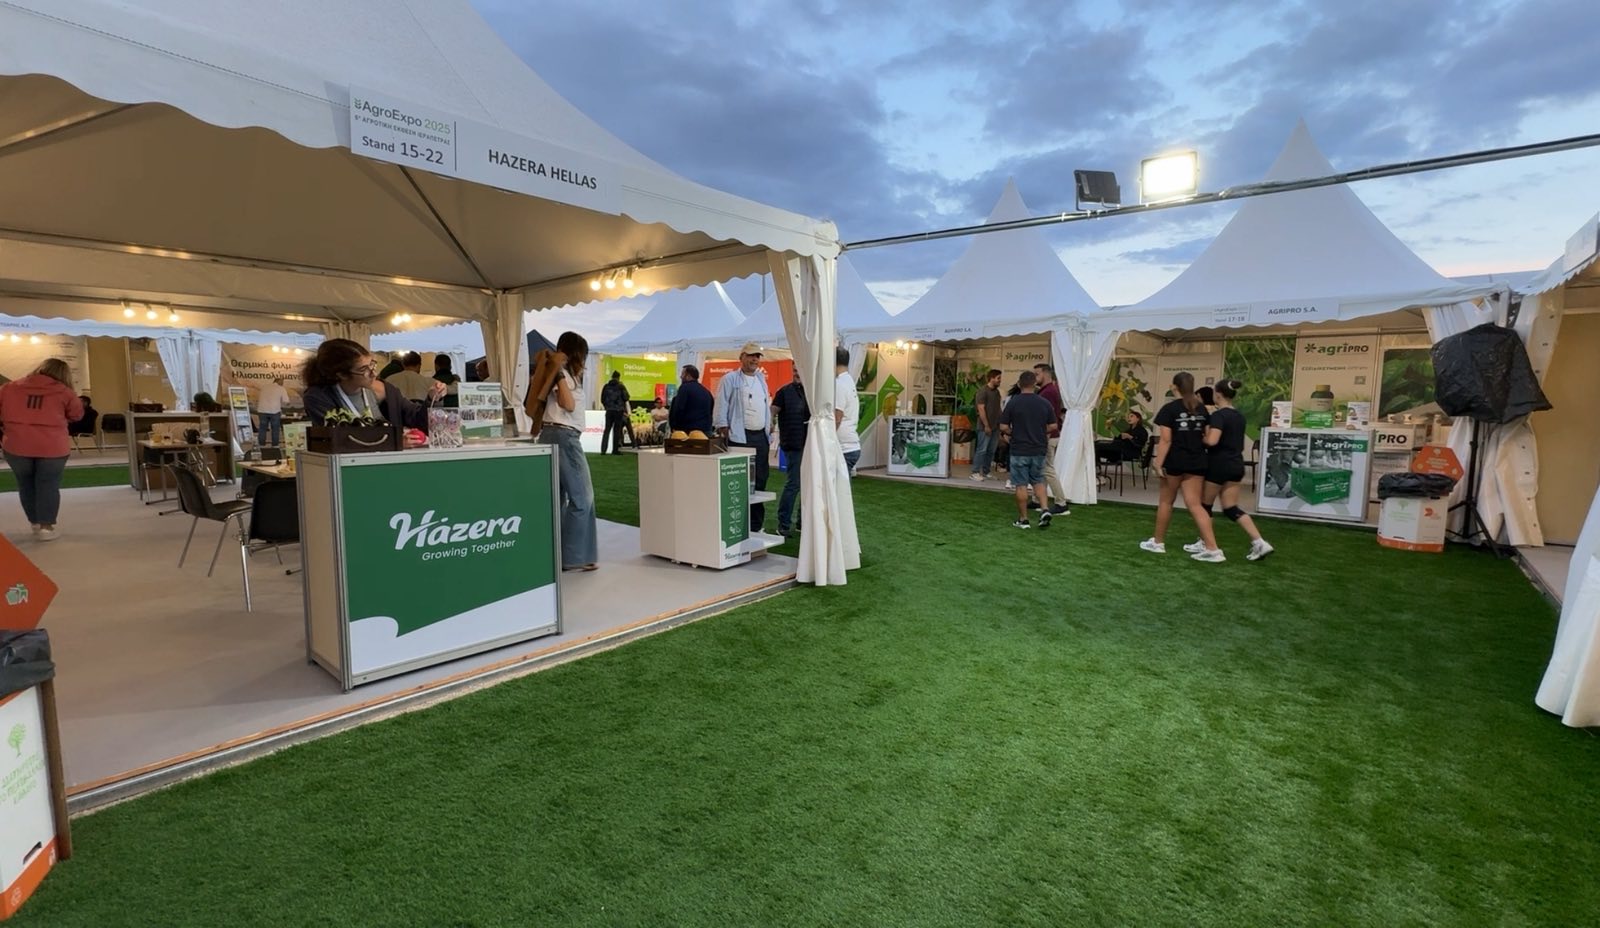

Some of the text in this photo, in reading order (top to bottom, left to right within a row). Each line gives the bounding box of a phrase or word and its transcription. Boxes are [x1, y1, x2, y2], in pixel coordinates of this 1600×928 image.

[362, 101, 451, 135] AgroExpo 2025
[362, 135, 444, 165] Stand 15-22
[488, 149, 597, 190] HAZERA HELLAS
[1268, 307, 1302, 315] AGRIPRO
[230, 359, 292, 370] Θερμικά φιλμ
[1376, 432, 1408, 444] PRO
[422, 539, 516, 562] Growing Together
